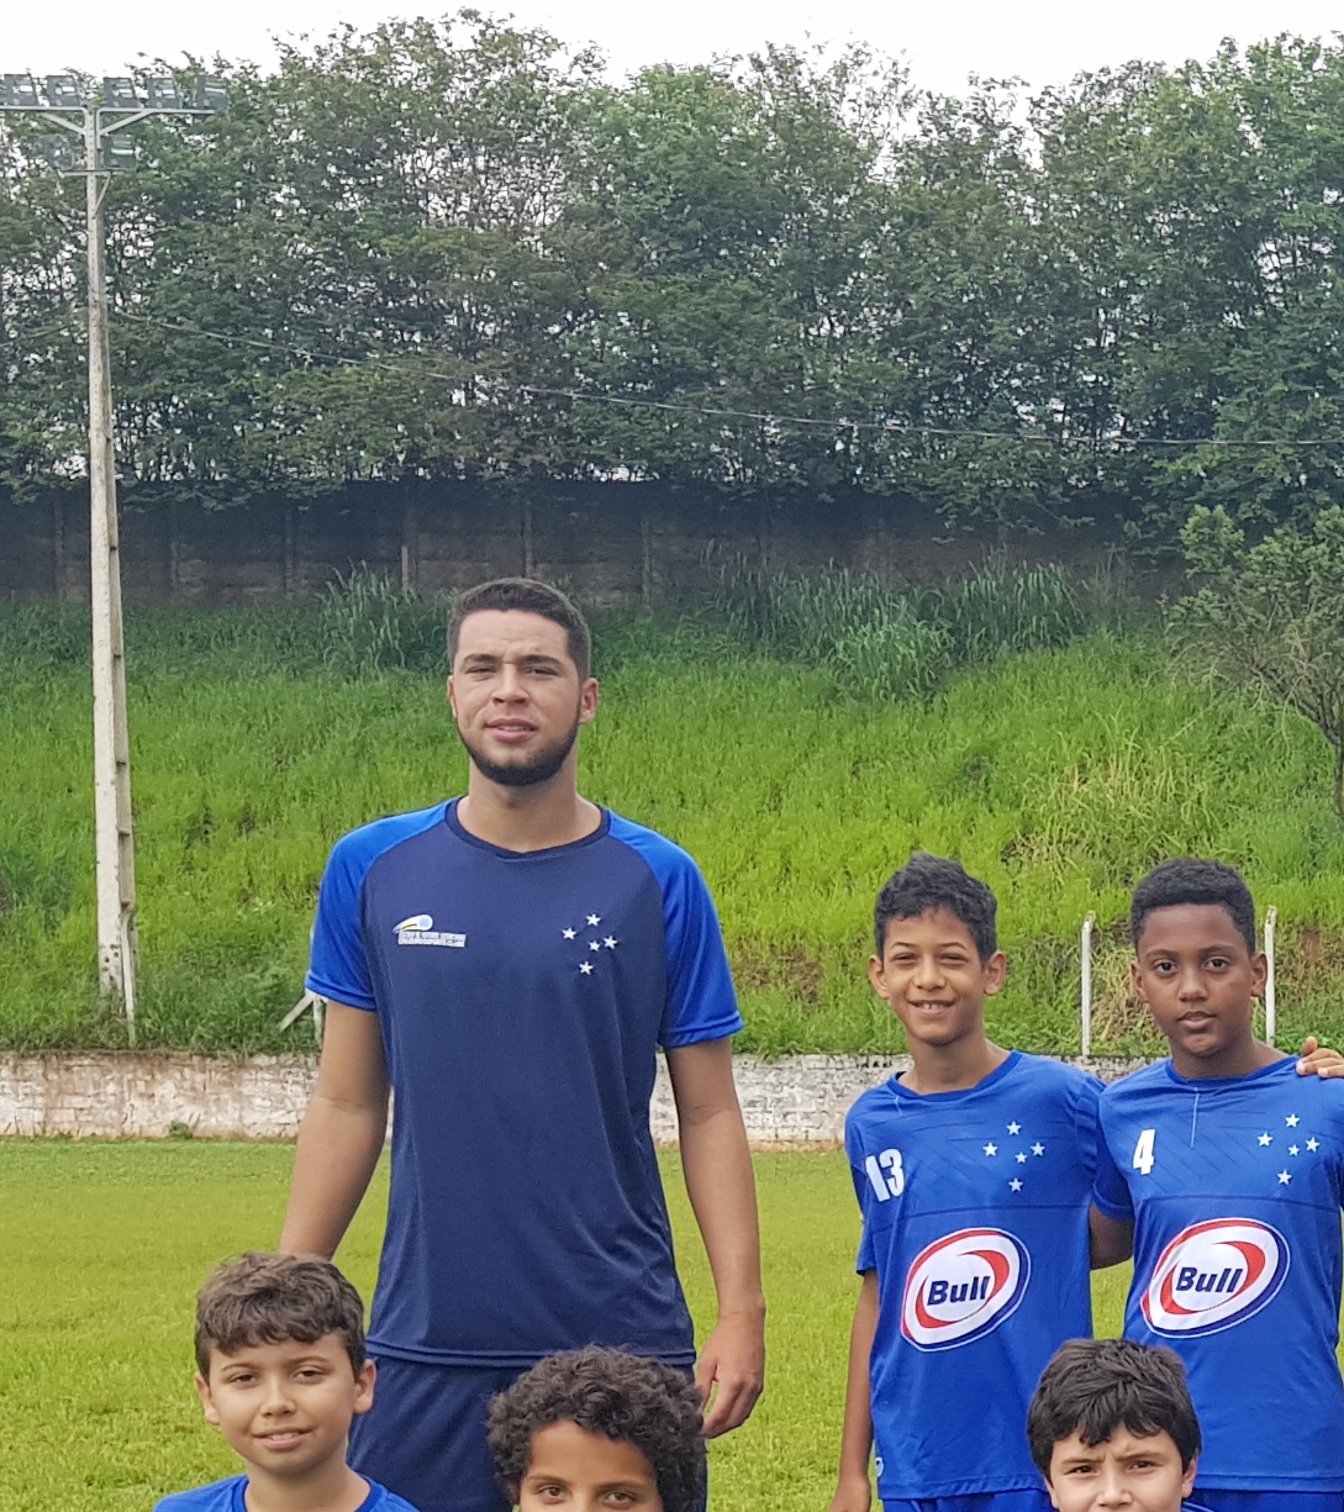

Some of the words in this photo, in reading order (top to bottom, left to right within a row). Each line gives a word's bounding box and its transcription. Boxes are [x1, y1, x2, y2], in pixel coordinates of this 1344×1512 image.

[1132, 1129, 1156, 1175] 4
[865, 1148, 904, 1203] 13
[927, 1275, 989, 1306] Bull
[1175, 1266, 1243, 1294] Bull
